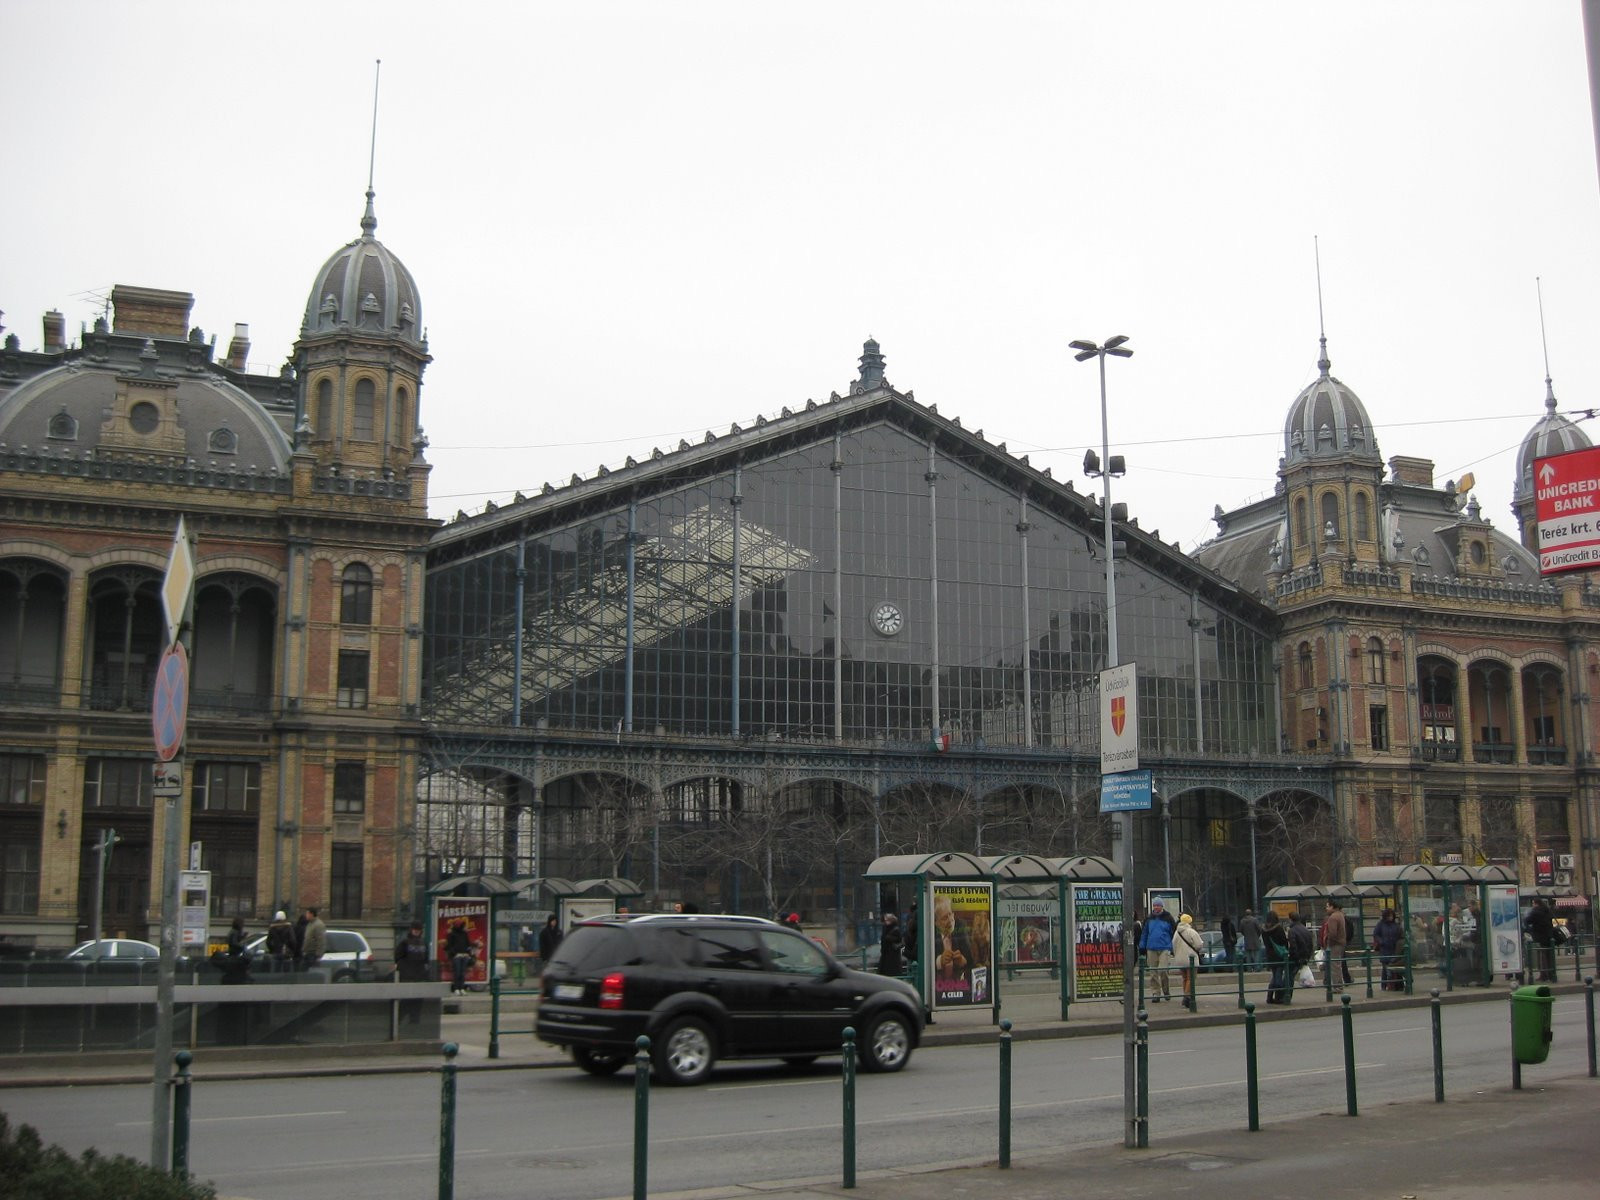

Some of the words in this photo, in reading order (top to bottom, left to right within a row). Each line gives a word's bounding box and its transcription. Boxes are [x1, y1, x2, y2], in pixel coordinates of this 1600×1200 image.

[1554, 495, 1594, 512] BANK
[1540, 525, 1567, 540] Teréz
[1571, 521, 1592, 535] krt.
[1552, 550, 1590, 565] UniCredit
[934, 886, 963, 895] VEREBES
[438, 903, 486, 918] PÁRSZÁZAS
[941, 991, 947, 999] A
